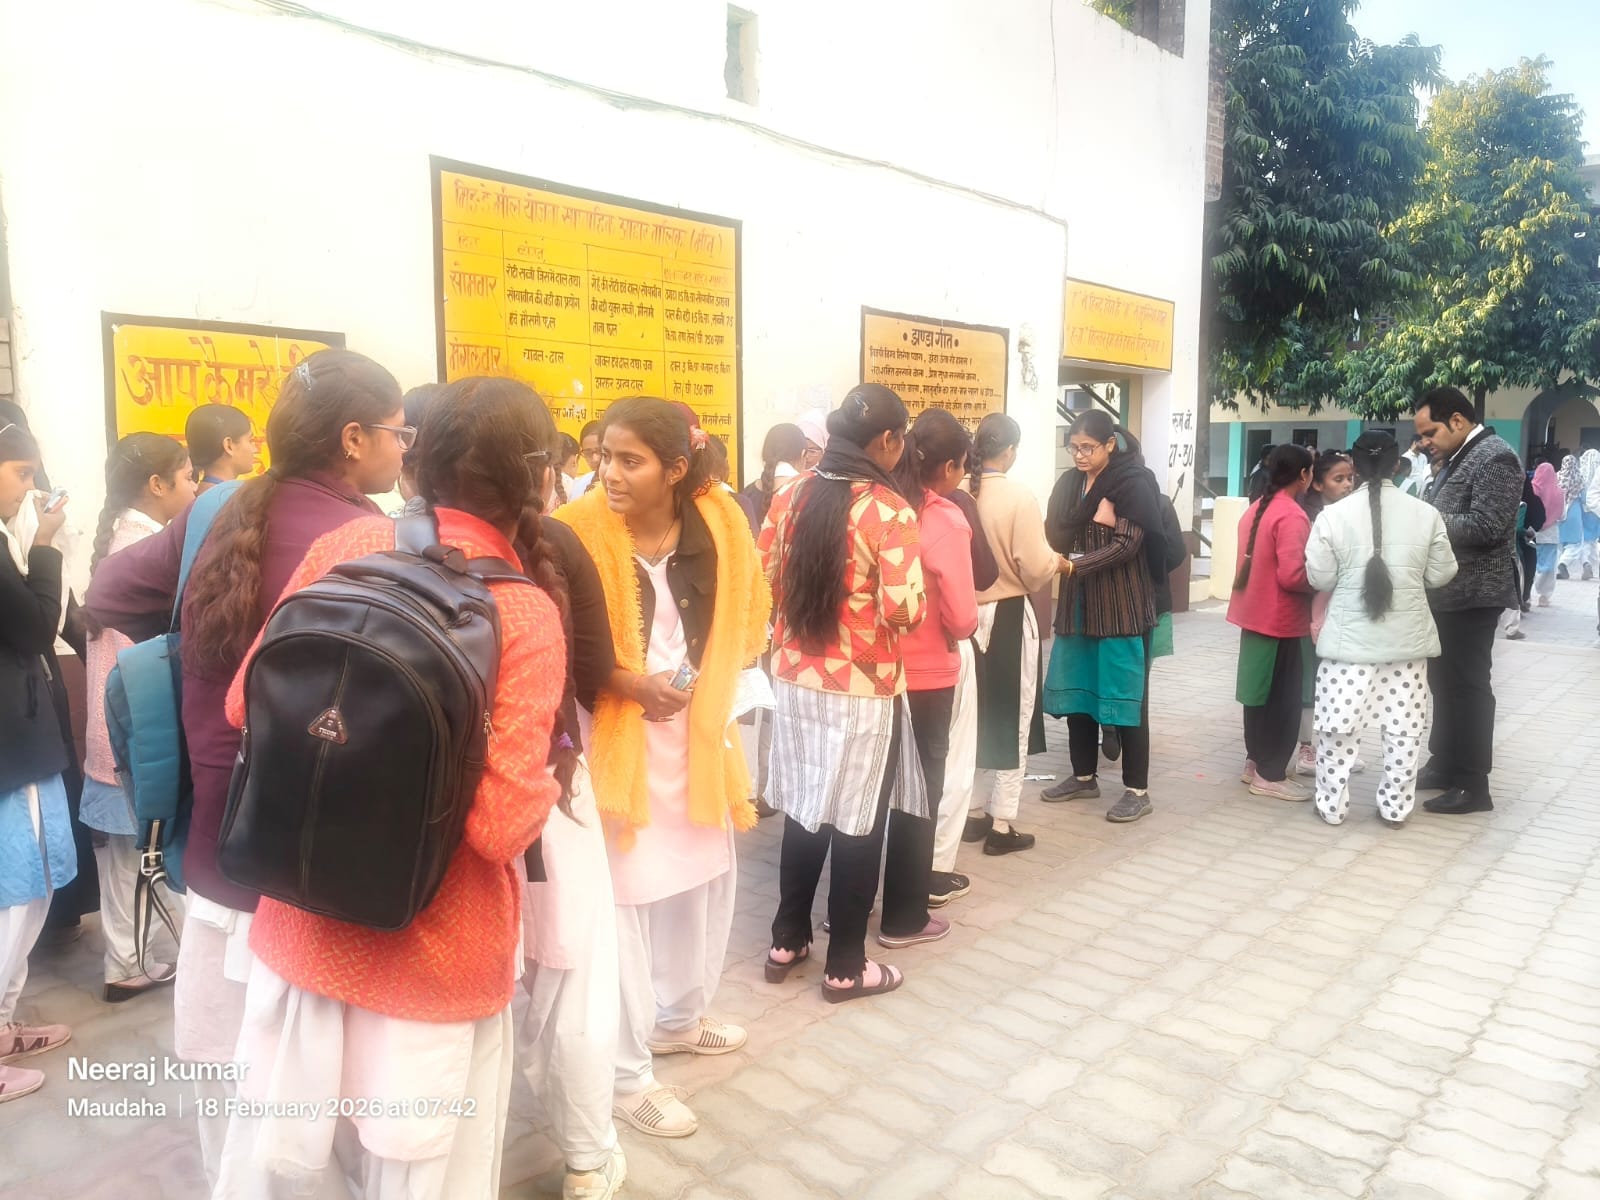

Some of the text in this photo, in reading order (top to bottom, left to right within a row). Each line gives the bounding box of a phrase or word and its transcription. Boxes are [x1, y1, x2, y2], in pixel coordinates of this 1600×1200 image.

[449, 260, 498, 298] सोमवार
[555, 273, 567, 286] दाल
[534, 290, 543, 305] की
[554, 295, 562, 308] का
[911, 328, 953, 349] झण्डा गीत
[449, 337, 501, 371] मंगलवार
[121, 354, 201, 406] आप
